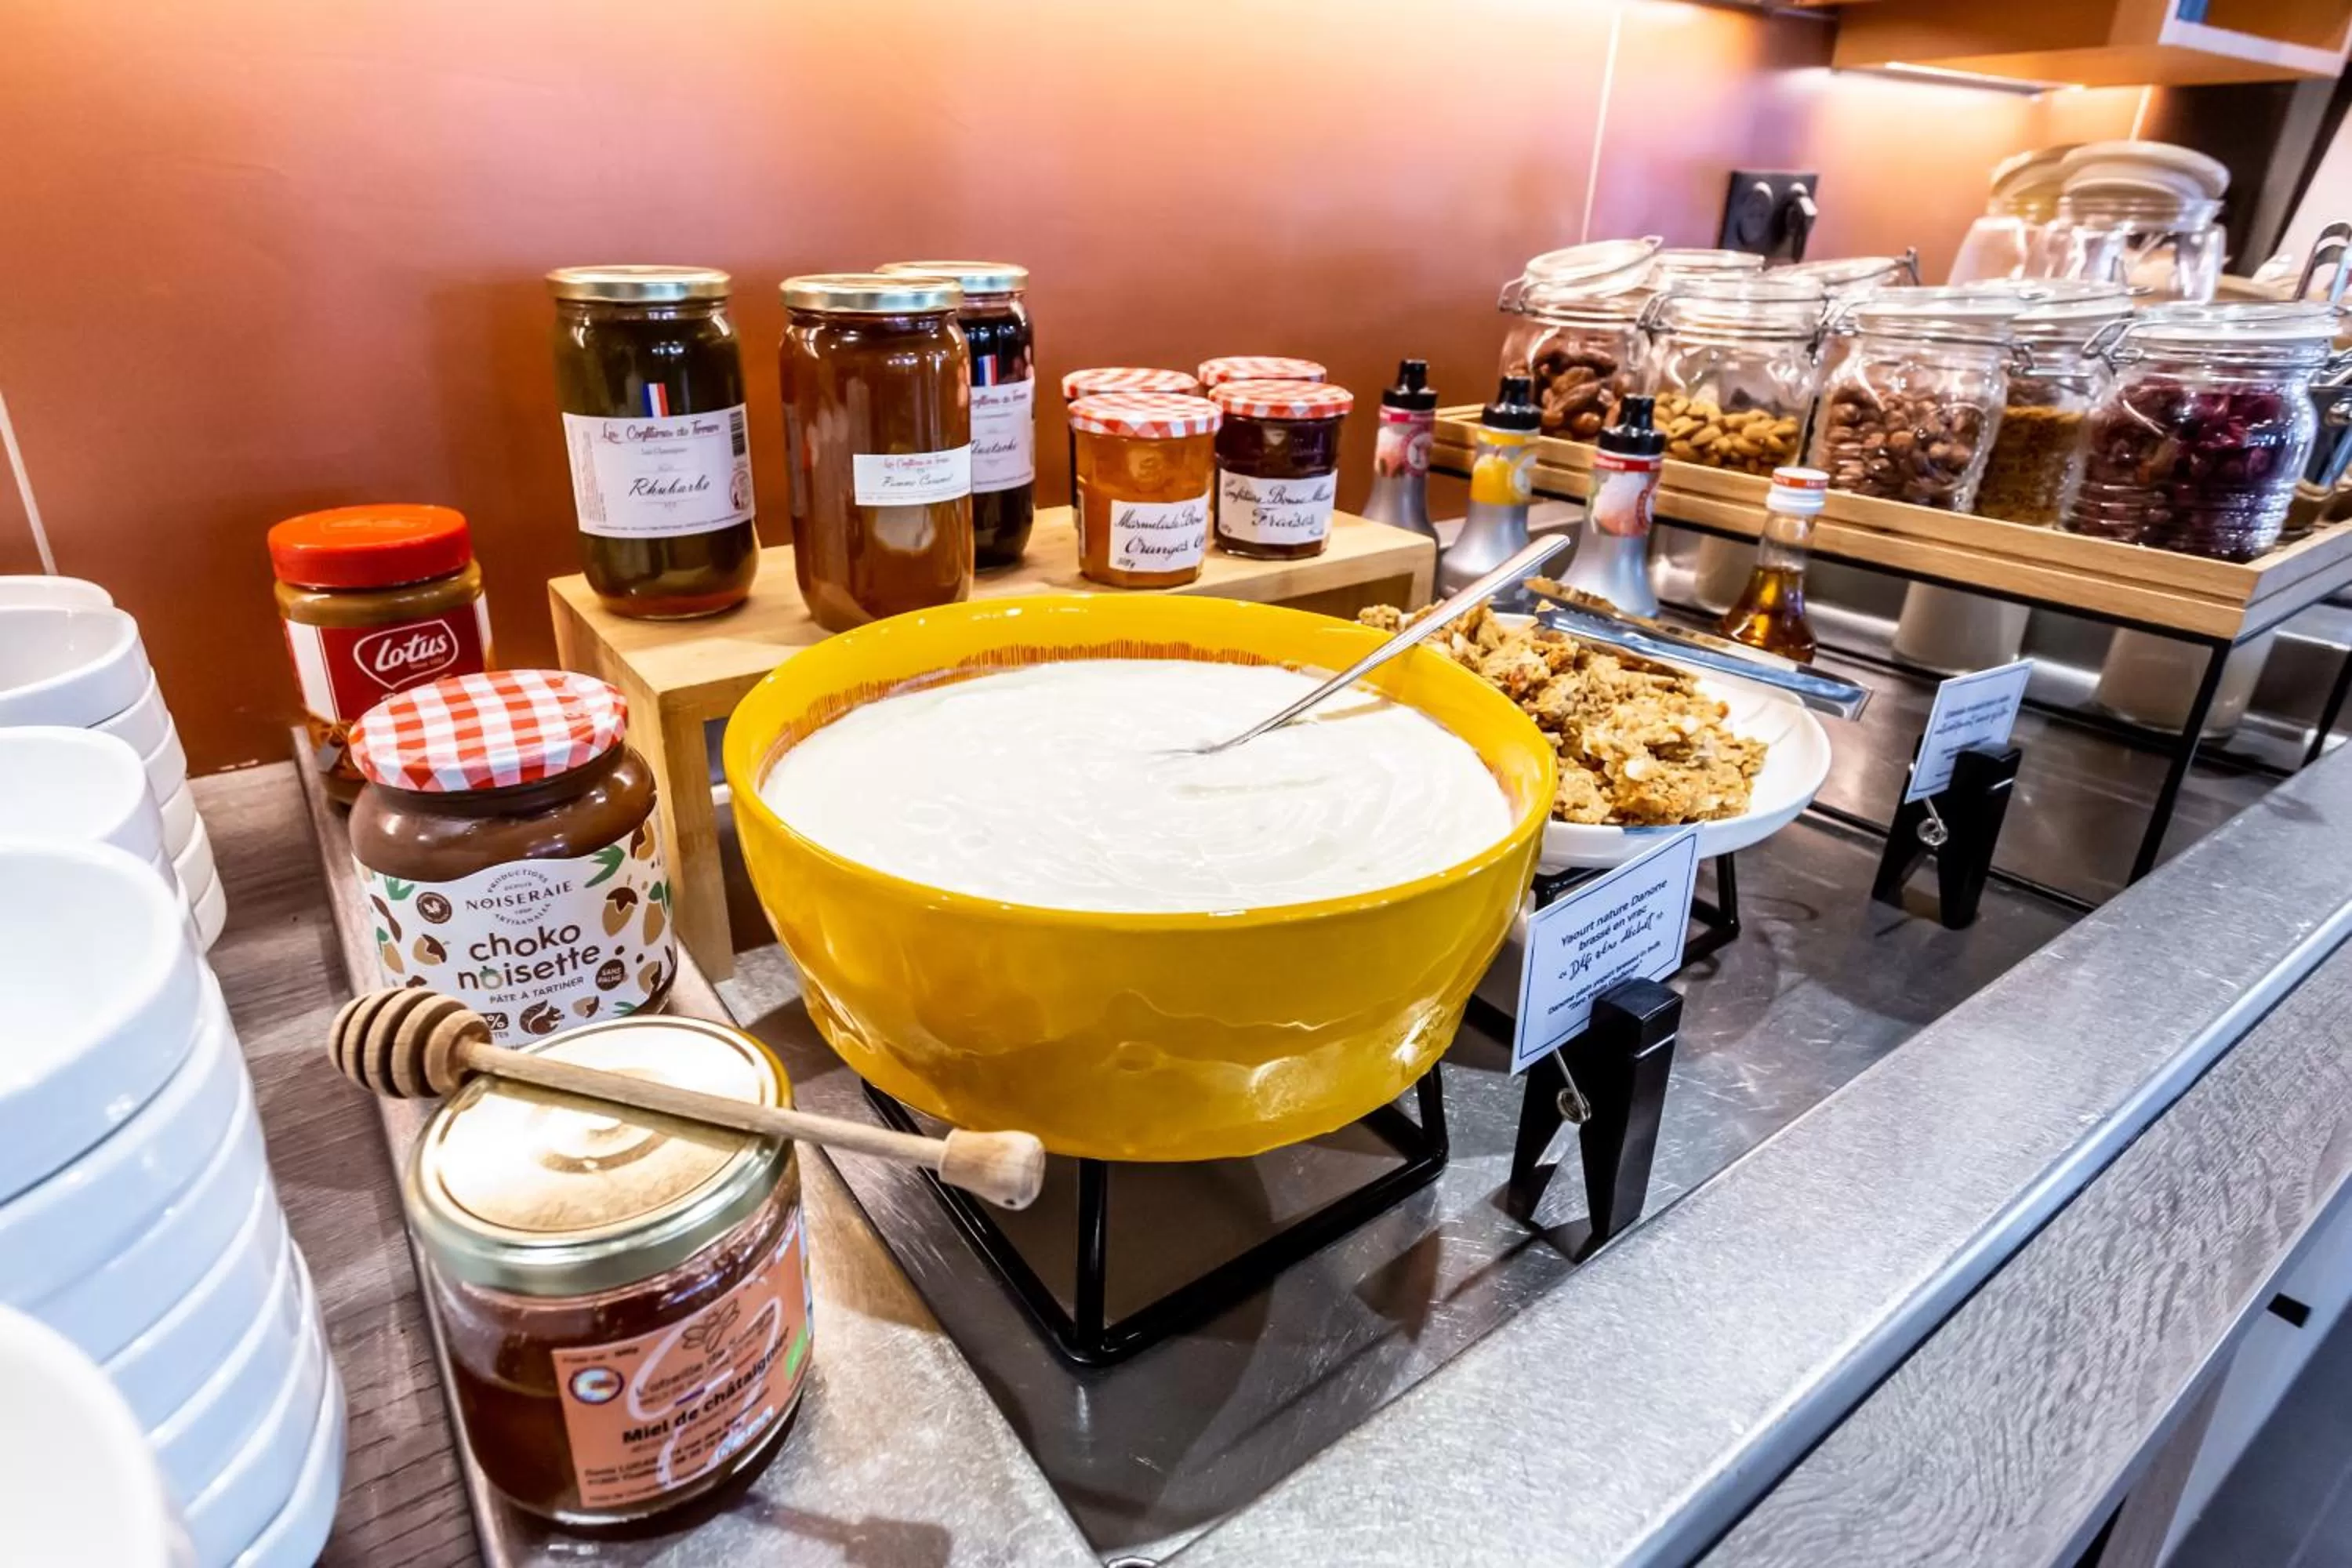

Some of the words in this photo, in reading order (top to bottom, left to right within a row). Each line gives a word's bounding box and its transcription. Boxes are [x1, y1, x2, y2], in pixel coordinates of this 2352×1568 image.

[629, 474, 710, 498] Rhubarbe
[1251, 508, 1315, 528] Fraises
[1124, 533, 1189, 561] Oranges
[375, 633, 448, 672] Lotus
[465, 880, 573, 910] NOISERAIE
[487, 869, 548, 893] PRODUCTIONS
[494, 902, 551, 925] ARTISANALES
[1561, 921, 1595, 947] Yaourt
[1596, 902, 1629, 927] nature
[1631, 879, 1668, 907] Danone
[1578, 924, 1612, 951] brassé
[1613, 918, 1626, 931] en
[1627, 905, 1647, 922] vrac
[469, 924, 581, 962] choko
[457, 945, 601, 990] noisette
[601, 967, 622, 976] SANS
[489, 993, 517, 1004] PÂTE
[532, 976, 585, 996] TARTINER
[622, 1420, 669, 1444] Miel
[673, 1408, 699, 1427] de
